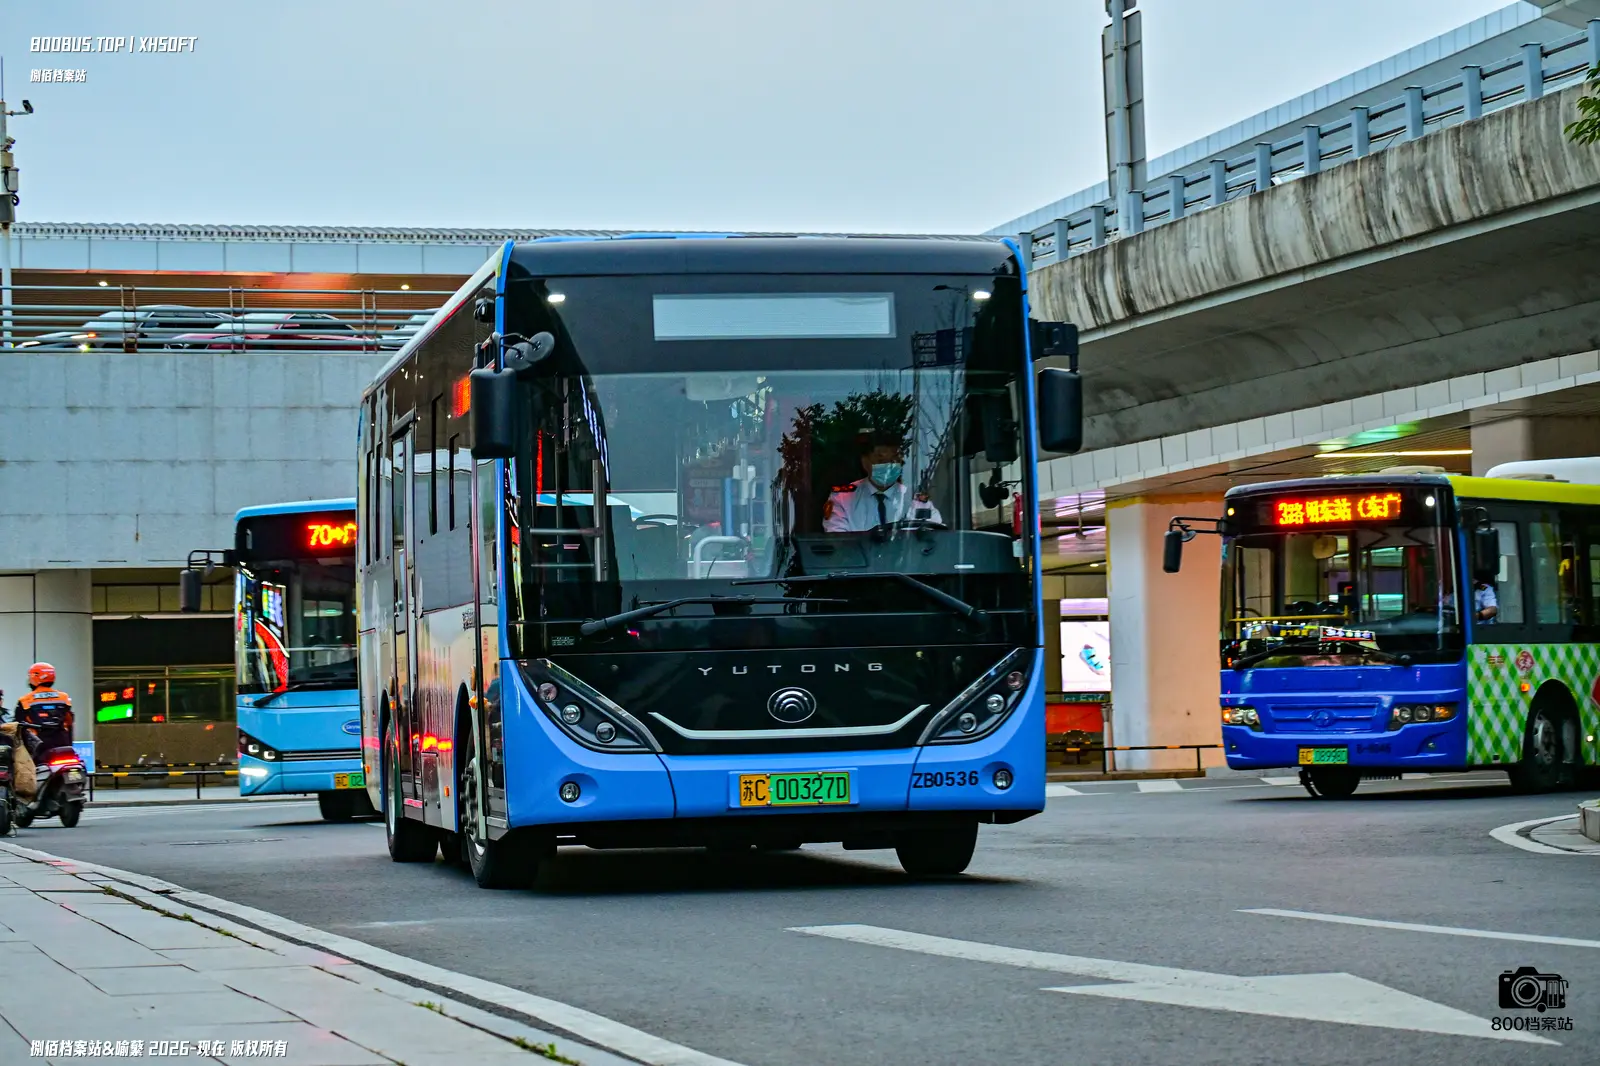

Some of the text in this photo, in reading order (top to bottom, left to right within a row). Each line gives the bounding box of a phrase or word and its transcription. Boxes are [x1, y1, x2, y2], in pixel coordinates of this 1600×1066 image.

[698, 662, 883, 676] YUTONG
[776, 776, 847, 800] 00327D
[912, 770, 979, 788] ZB0536
